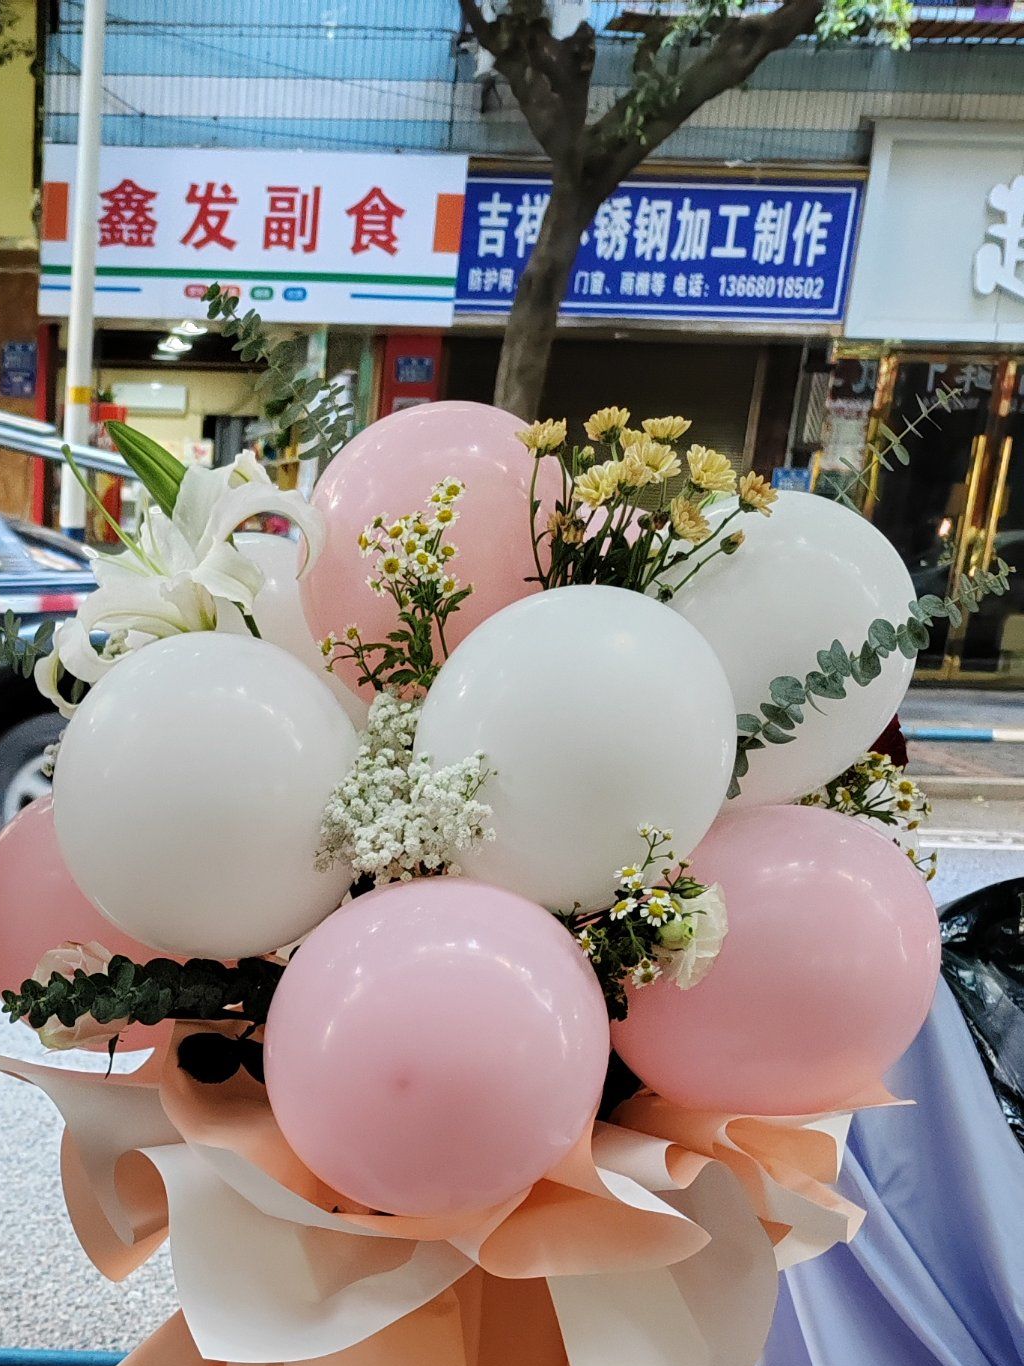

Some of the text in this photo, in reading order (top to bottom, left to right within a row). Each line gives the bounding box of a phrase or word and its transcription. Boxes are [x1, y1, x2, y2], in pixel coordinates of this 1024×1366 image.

[98, 178, 406, 256] 鑫发副食
[476, 191, 834, 268] 吉祥锈钢加工制作
[718, 274, 825, 300] 13668018502
